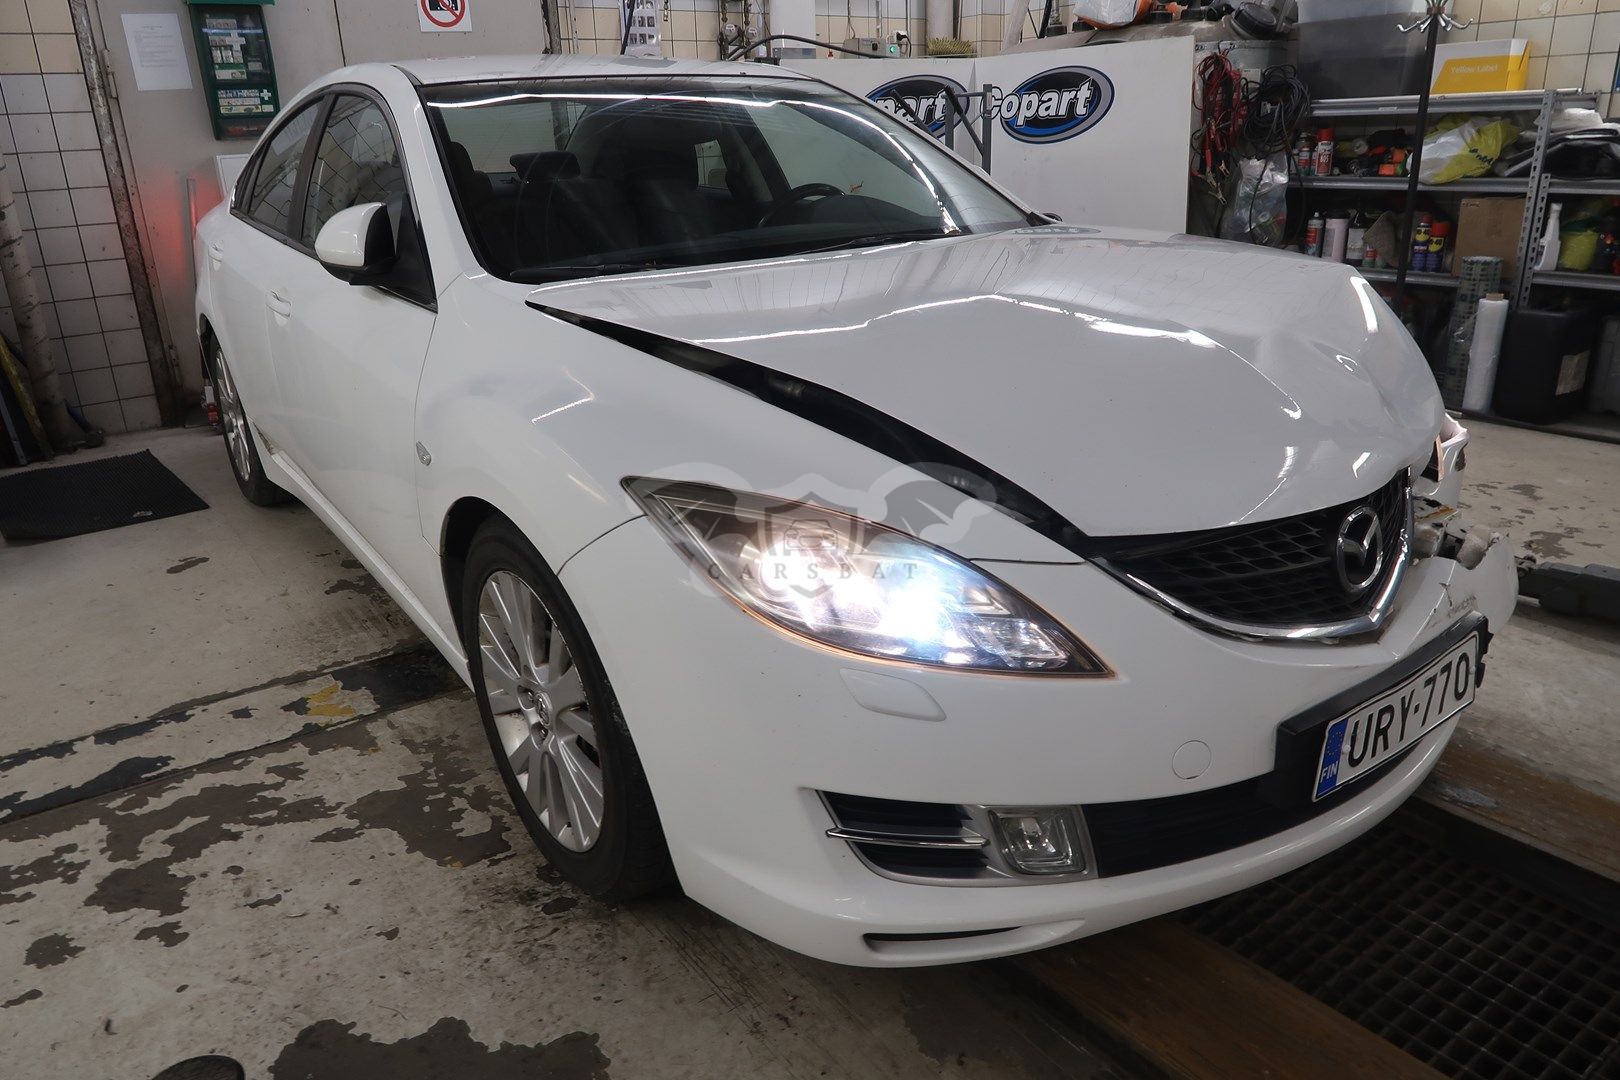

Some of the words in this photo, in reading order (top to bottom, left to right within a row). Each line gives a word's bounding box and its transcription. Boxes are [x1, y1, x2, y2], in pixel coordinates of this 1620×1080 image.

[1450, 64, 1475, 73] Yellow
[1477, 63, 1498, 72] Label
[876, 90, 947, 123] part
[1348, 653, 1470, 767] URY-770
[1320, 762, 1338, 782] FIN
